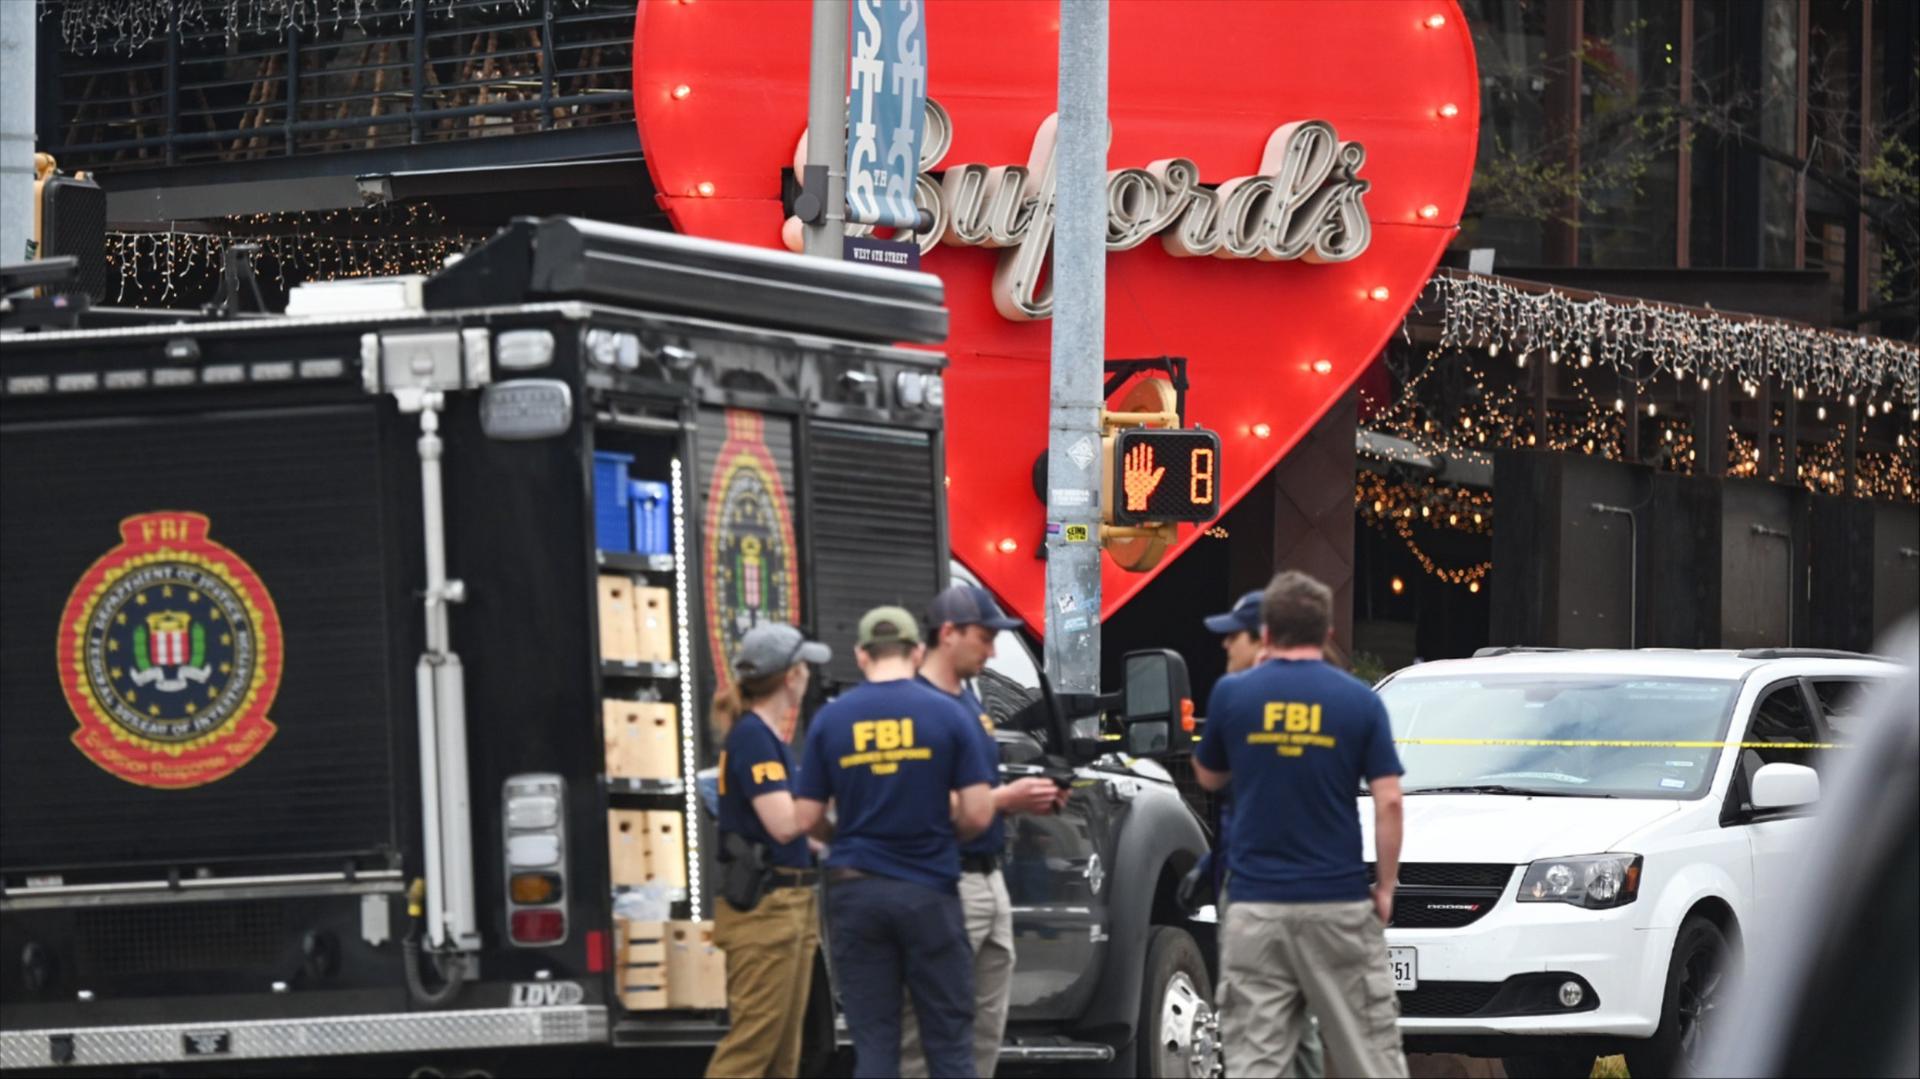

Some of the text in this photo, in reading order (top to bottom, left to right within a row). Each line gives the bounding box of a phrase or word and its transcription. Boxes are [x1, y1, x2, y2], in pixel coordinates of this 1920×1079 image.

[853, 247, 909, 265] WEST 6TH STREET
[1191, 448, 1213, 504] 8
[142, 519, 189, 542] FBI
[1264, 702, 1321, 733] FBI
[853, 718, 913, 751] FBI
[511, 983, 561, 1007] LDV
